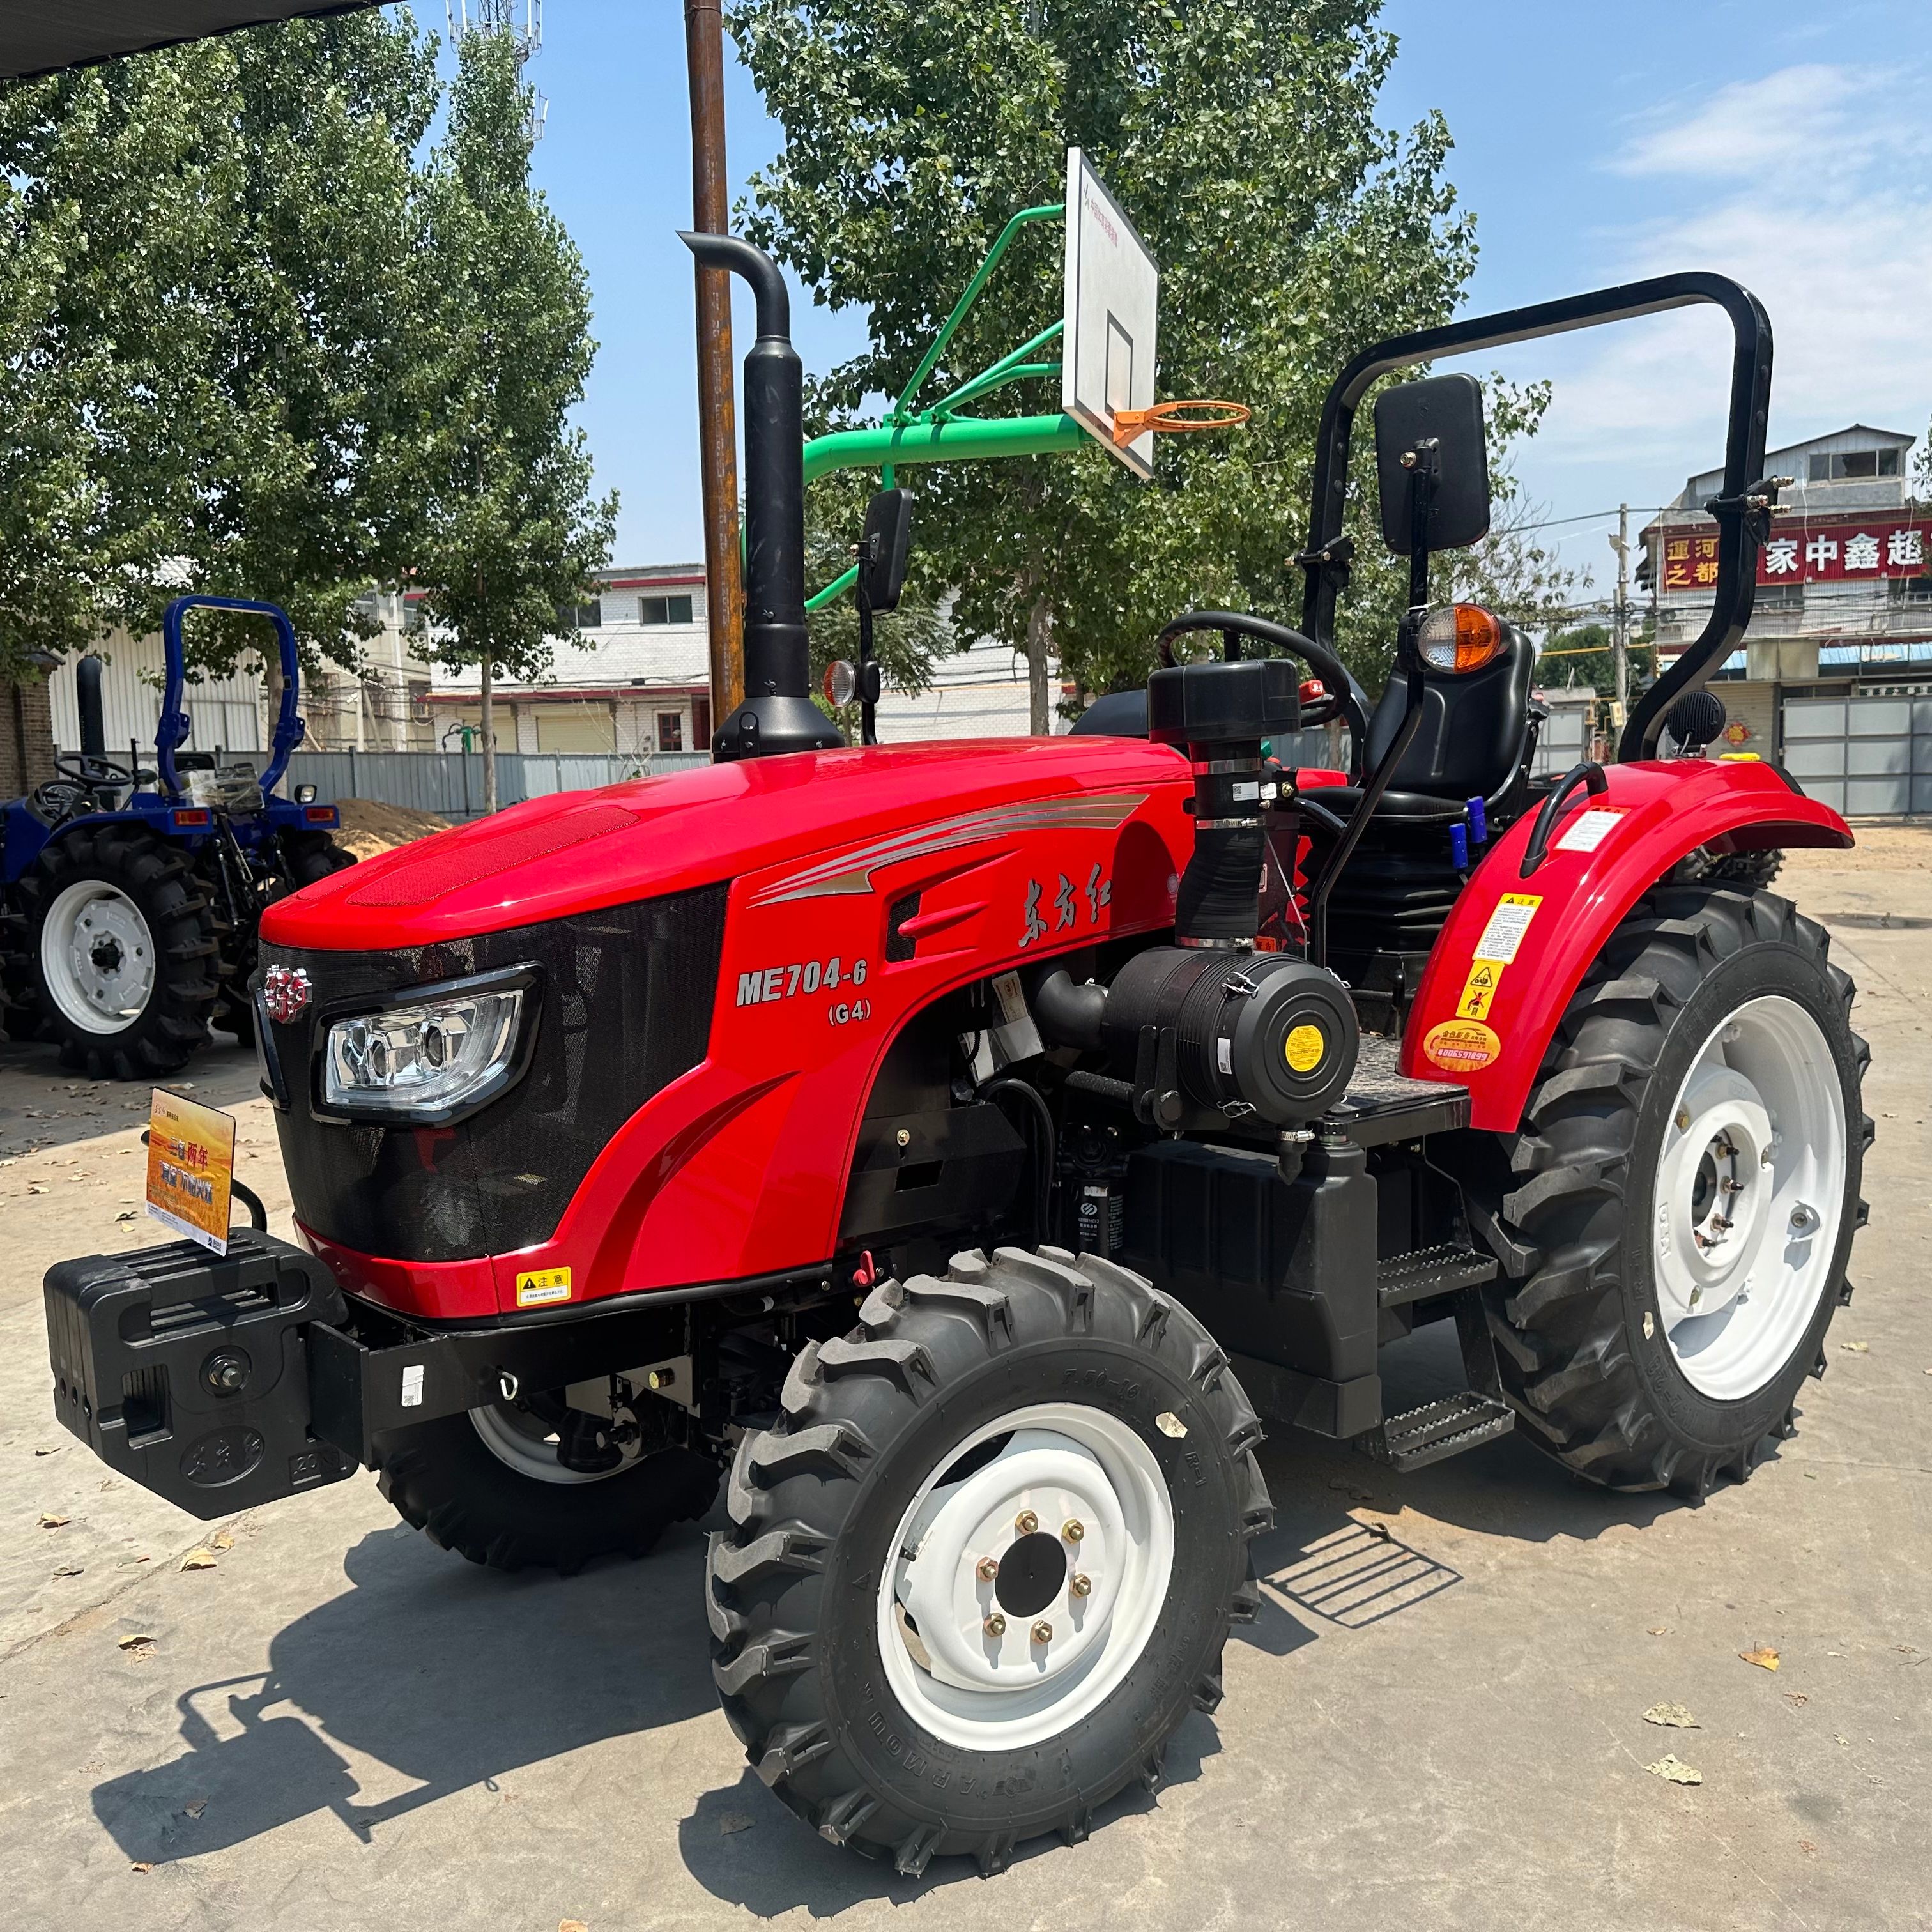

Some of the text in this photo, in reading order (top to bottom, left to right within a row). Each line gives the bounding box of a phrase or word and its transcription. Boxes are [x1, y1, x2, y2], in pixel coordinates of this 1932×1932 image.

[1667, 537, 1719, 561] 運河
[1765, 529, 1932, 575] 家中鑫超
[1666, 562, 1719, 585] 之都
[1018, 862, 1113, 949] 东方红
[735, 957, 868, 1008] ME704-6
[828, 999, 870, 1026] (G4)
[537, 1274, 564, 1287] 注意
[1061, 1367, 1140, 1399] 7.50-16
[1184, 1450, 1208, 1487] R-1
